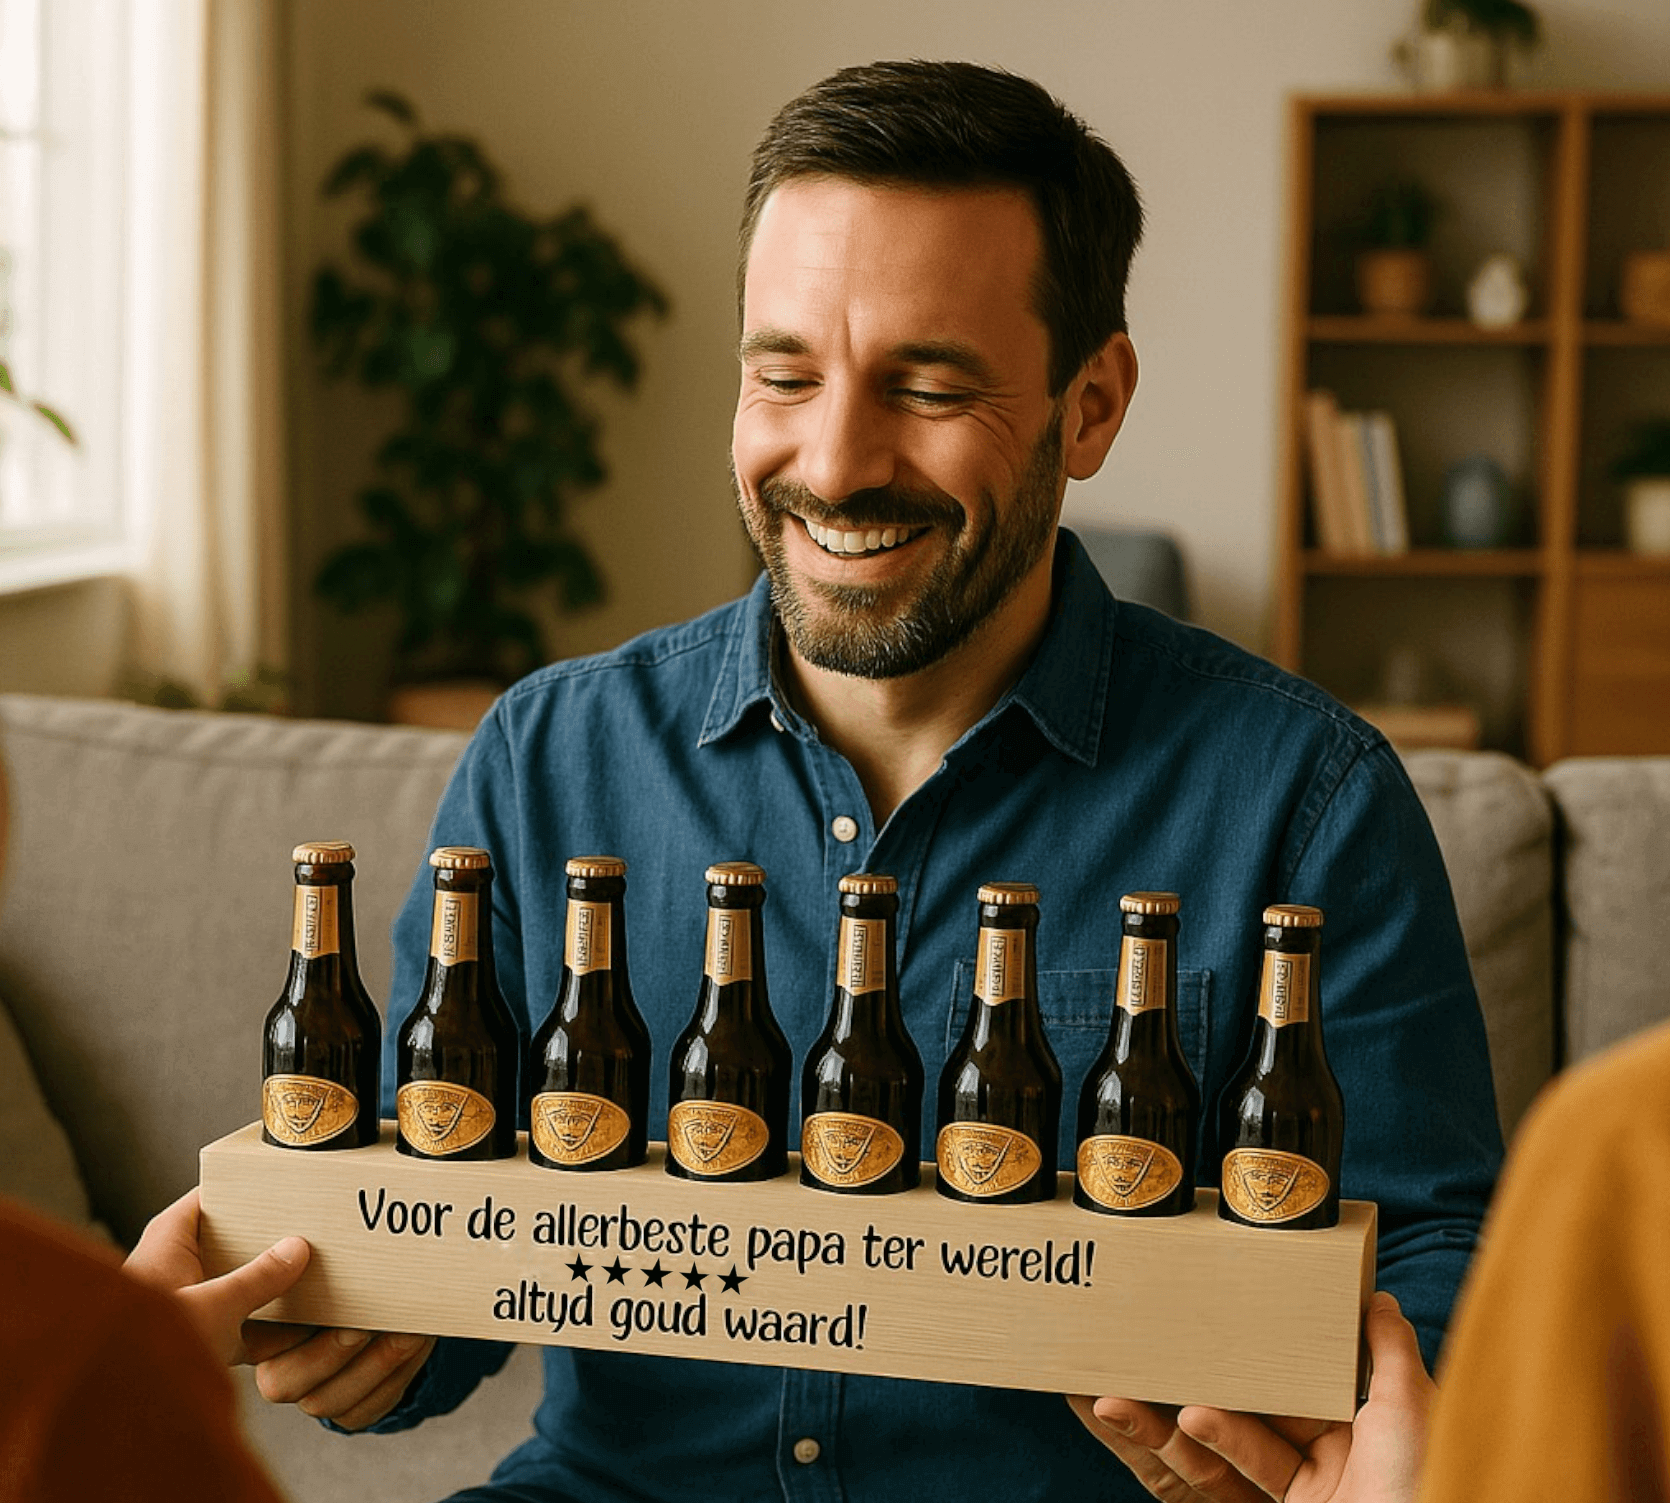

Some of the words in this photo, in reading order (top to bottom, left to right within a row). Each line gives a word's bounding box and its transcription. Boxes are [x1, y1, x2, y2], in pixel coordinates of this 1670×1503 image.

[358, 1188, 454, 1238] Voor
[467, 1196, 515, 1241] de
[533, 1204, 731, 1262] allerbeste
[747, 1225, 846, 1275] papa
[862, 1225, 926, 1271] ter
[941, 1240, 1096, 1289] wereld!
[610, 1293, 707, 1341] goud
[724, 1304, 868, 1350] waard!
